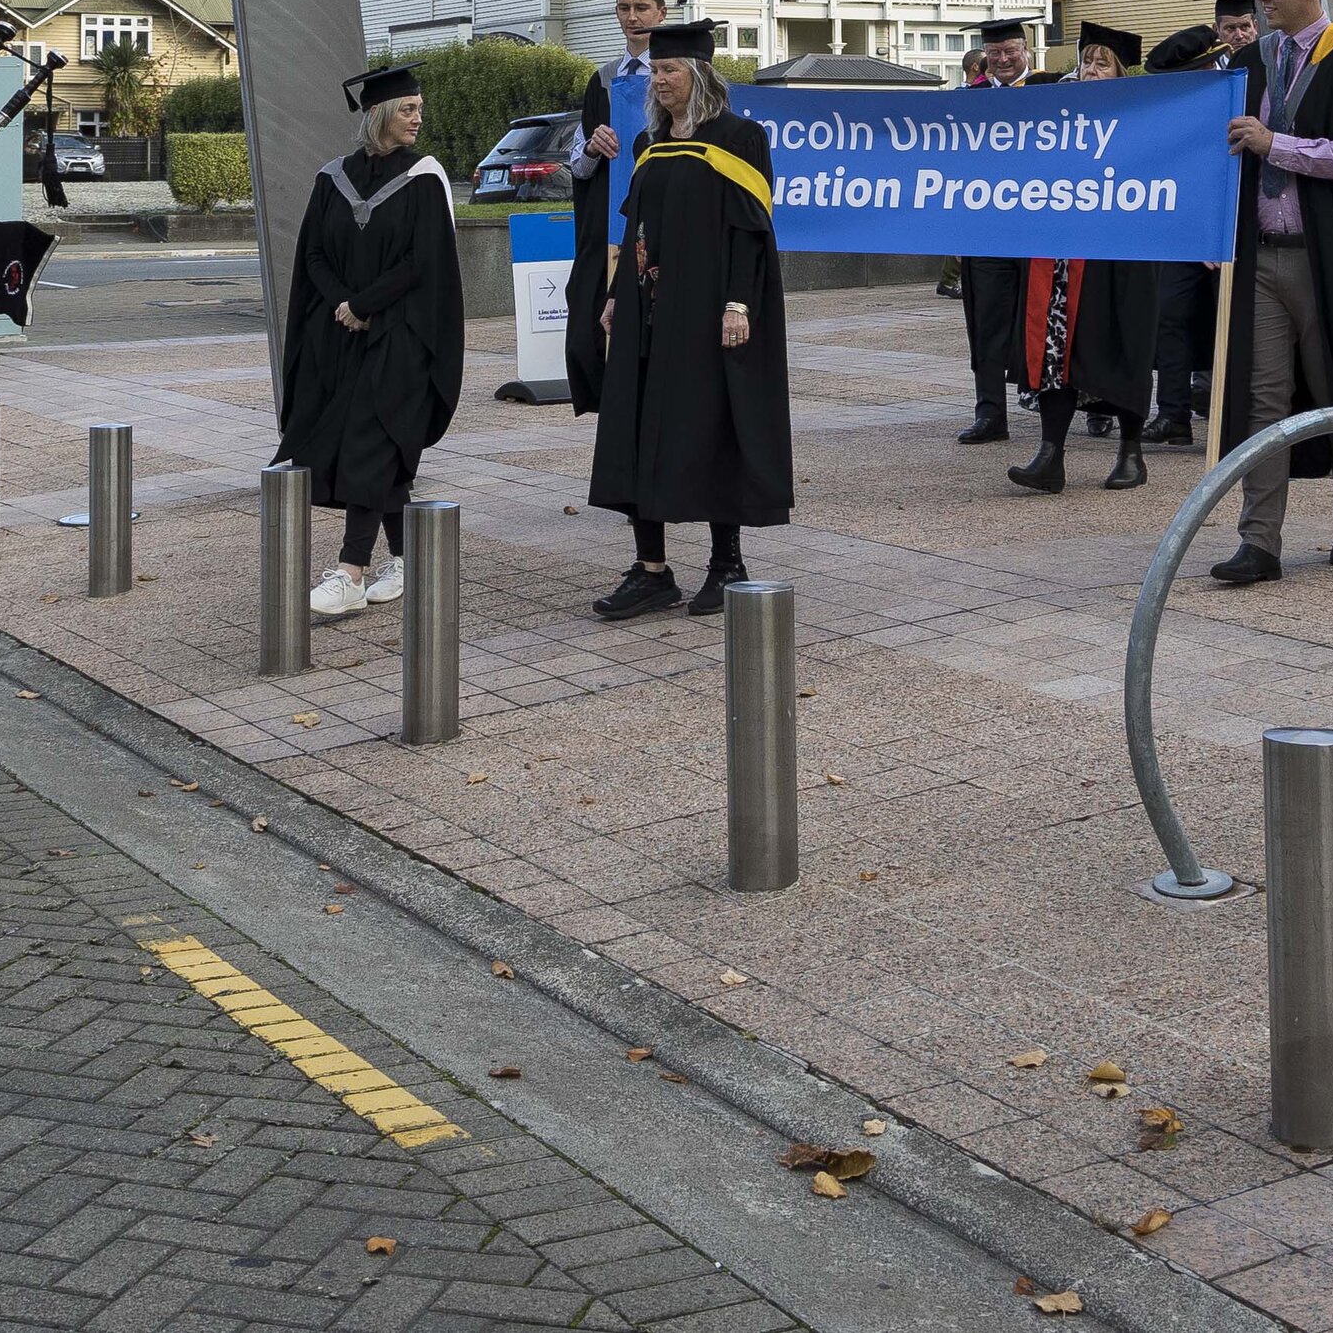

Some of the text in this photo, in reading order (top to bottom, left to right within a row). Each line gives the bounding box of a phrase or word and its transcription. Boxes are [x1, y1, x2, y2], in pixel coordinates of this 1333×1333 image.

[743, 108, 1118, 160] ncoln University
[772, 166, 1178, 212] uation Procession
